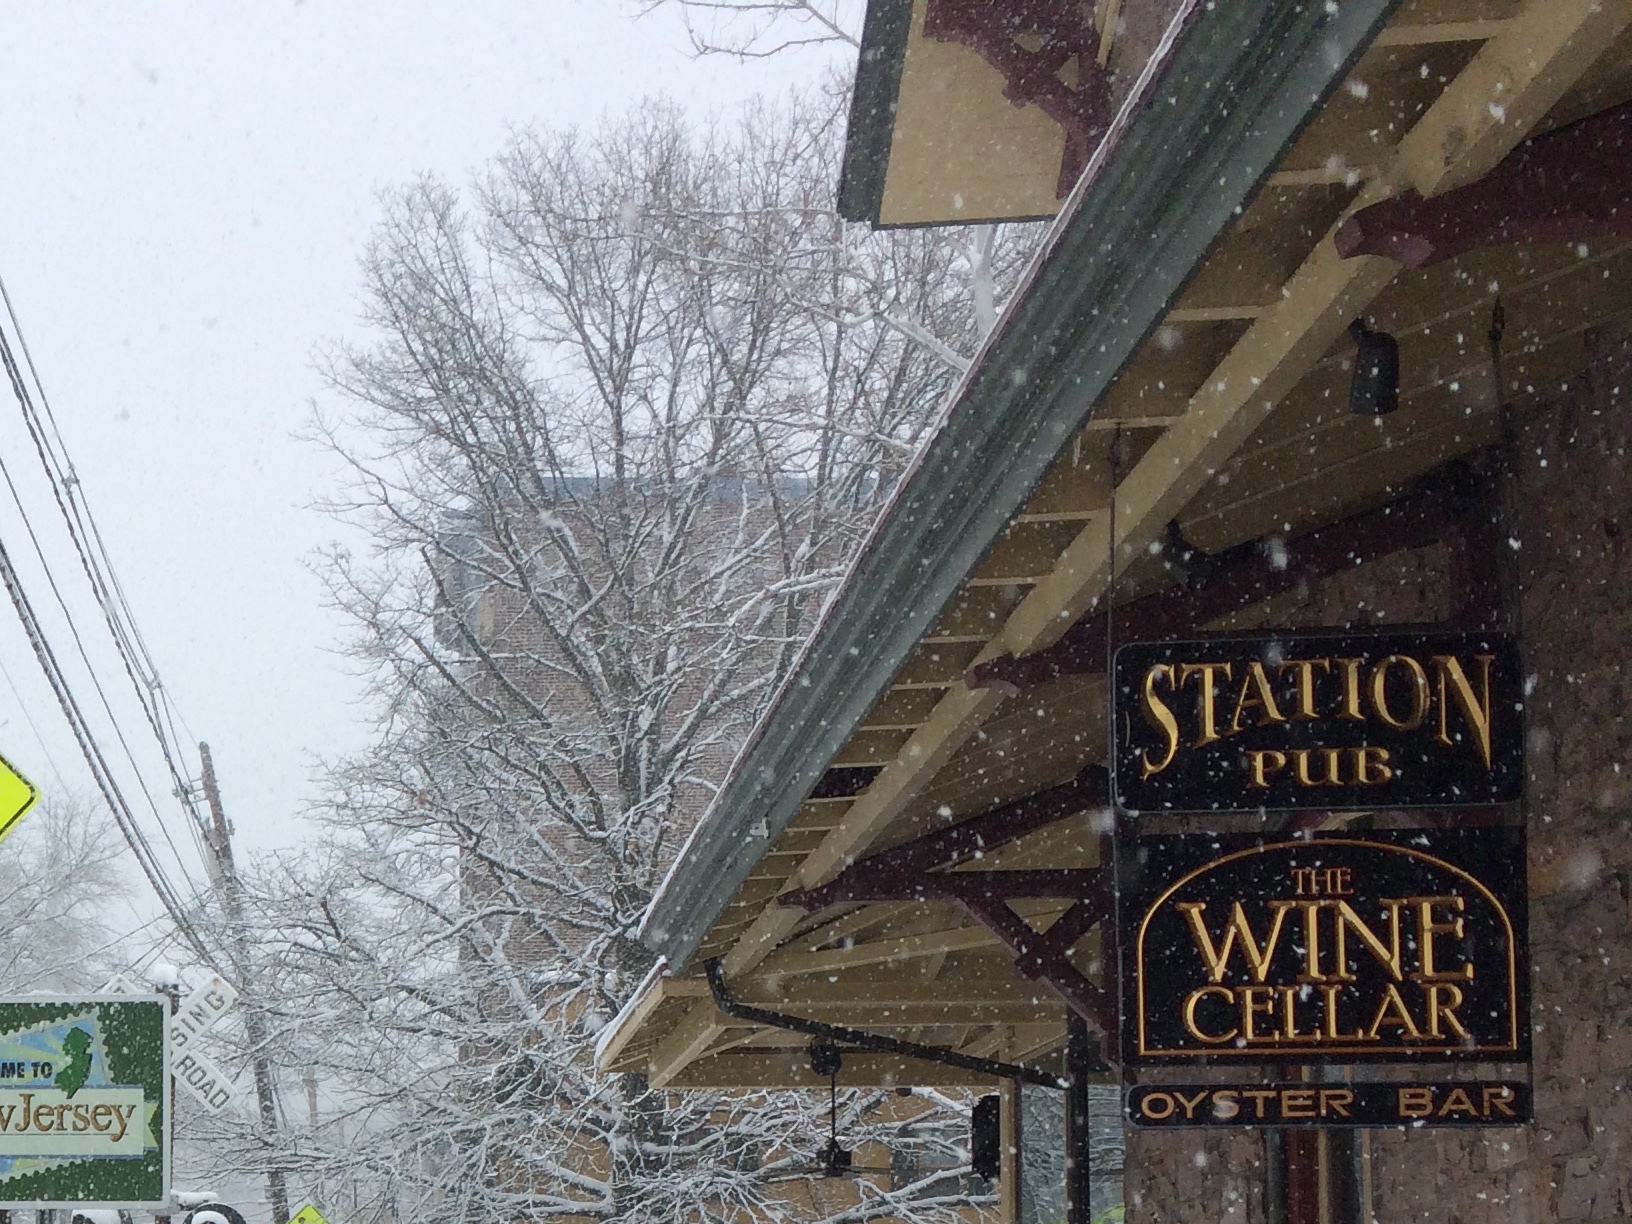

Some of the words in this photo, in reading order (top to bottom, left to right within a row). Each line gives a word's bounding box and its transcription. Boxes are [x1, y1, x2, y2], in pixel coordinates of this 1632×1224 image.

[1141, 653, 1496, 779] STATION
[1245, 747, 1394, 789] PUB
[1290, 867, 1354, 895] THE
[1175, 896, 1475, 983] WINE
[171, 990, 226, 1047] SING
[1183, 984, 1472, 1044] CELLAR
[31, 1061, 53, 1079] TO
[175, 1053, 231, 1109] ROAD
[1140, 1089, 1354, 1120] OYSTER
[1398, 1087, 1516, 1118] BAR
